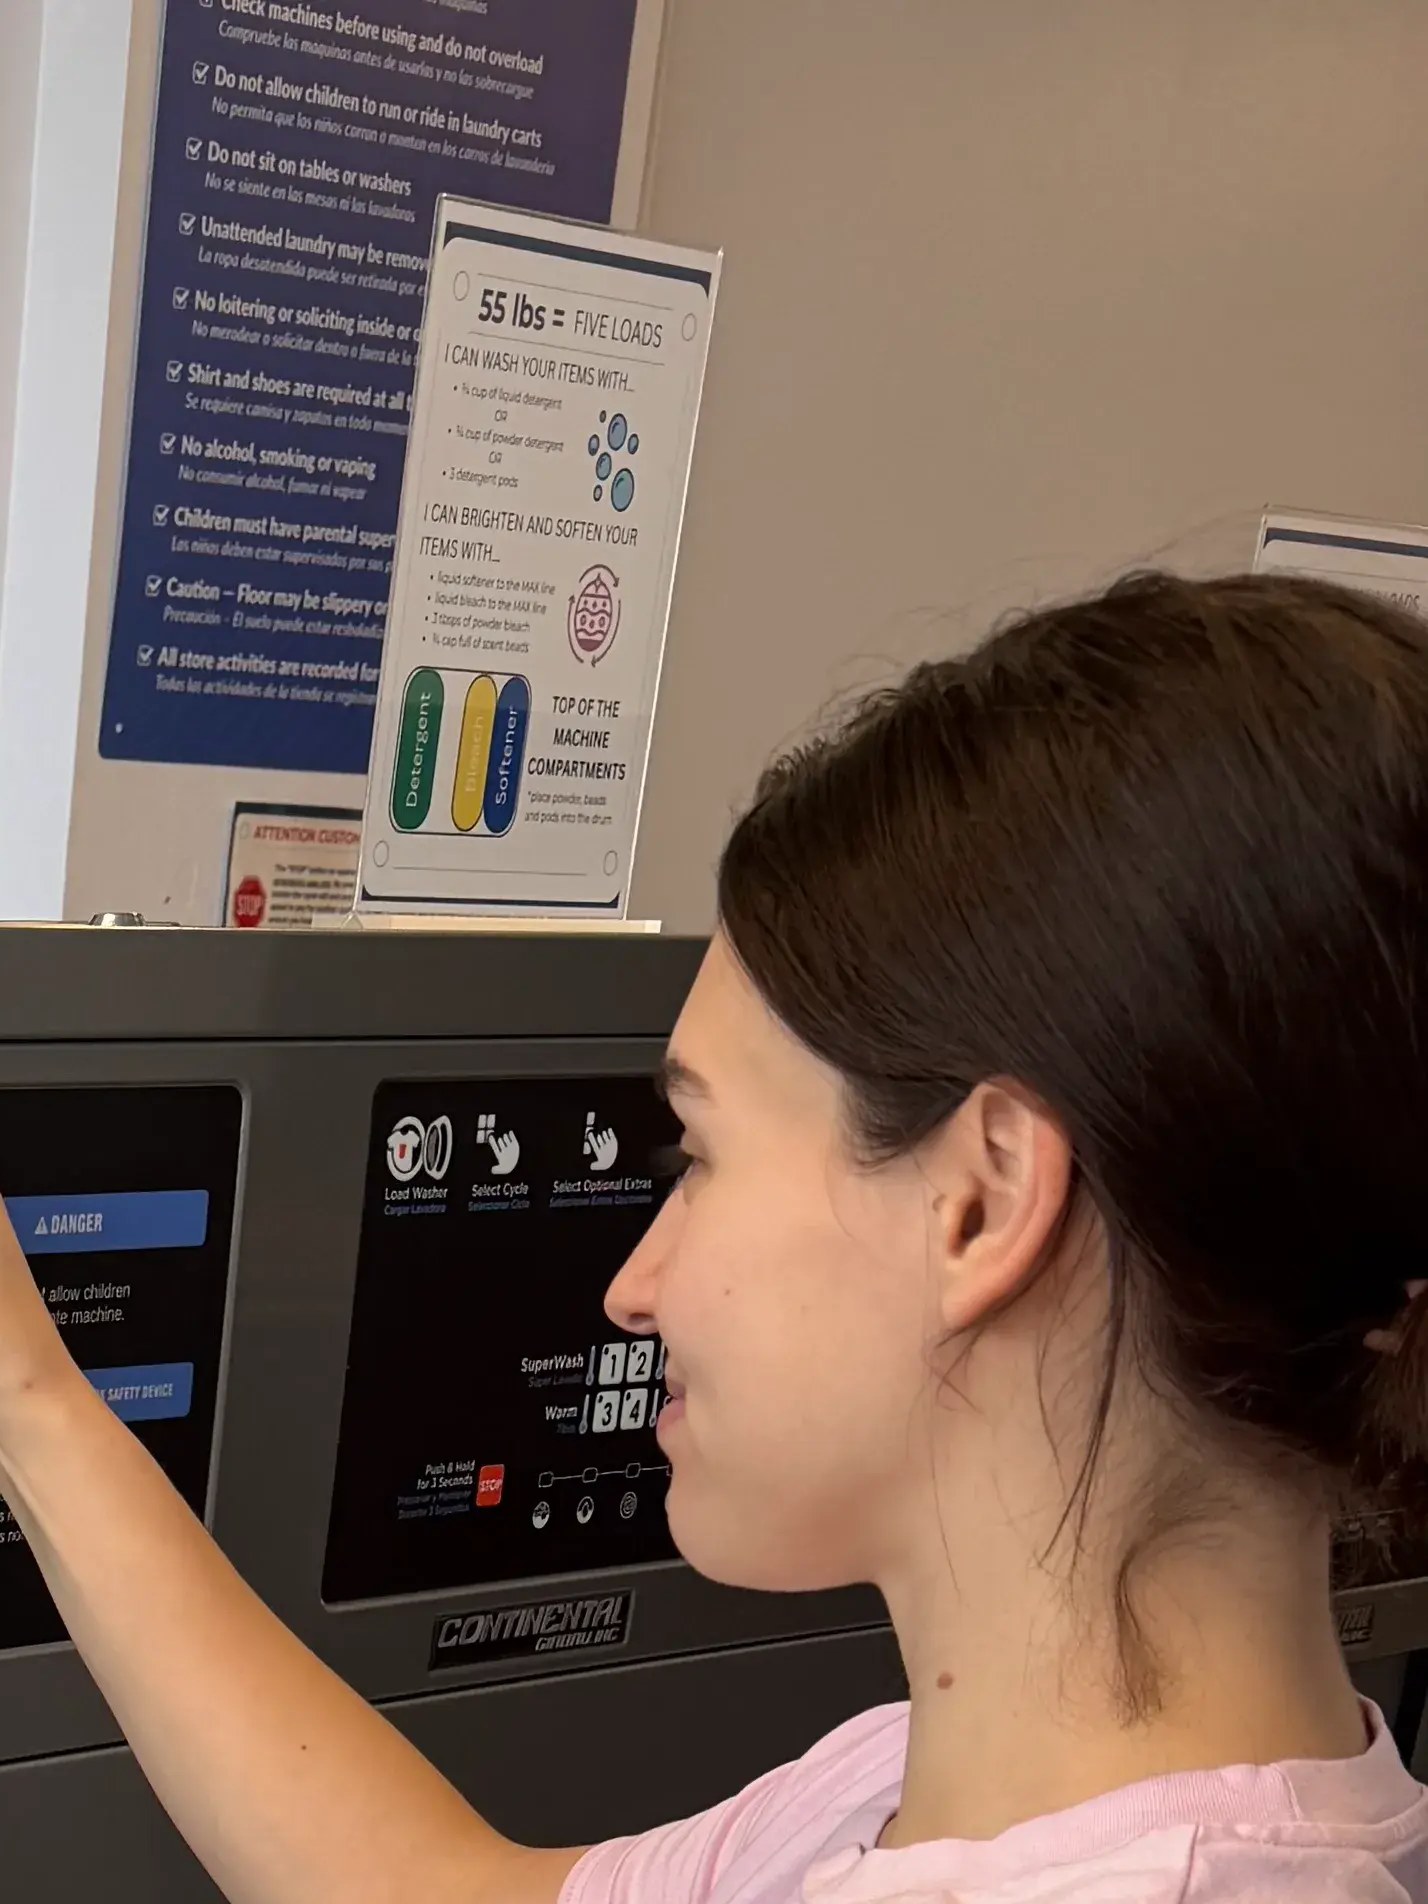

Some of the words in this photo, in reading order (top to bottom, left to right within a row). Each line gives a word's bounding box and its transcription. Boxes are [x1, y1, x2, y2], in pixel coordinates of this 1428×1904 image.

[207, 140, 230, 164] Do
[231, 150, 256, 169] not
[258, 150, 277, 173] sit
[277, 158, 297, 176] on
[299, 158, 340, 184] tables
[342, 170, 358, 186] or
[359, 172, 412, 196] washers
[477, 288, 508, 324] 55
[511, 292, 547, 331] lbs
[574, 309, 609, 339] FIVE
[611, 317, 663, 349] LOADS
[552, 695, 576, 714] TOP
[577, 697, 595, 716] OF
[597, 699, 621, 719] THE
[406, 692, 431, 807] Detergent
[495, 705, 519, 804] Softener
[553, 727, 611, 749] MACHINE
[527, 757, 626, 781] COMPARTMENTS
[50, 1212, 103, 1234] DANGER
[438, 1599, 625, 1651] CONTINENTAL
